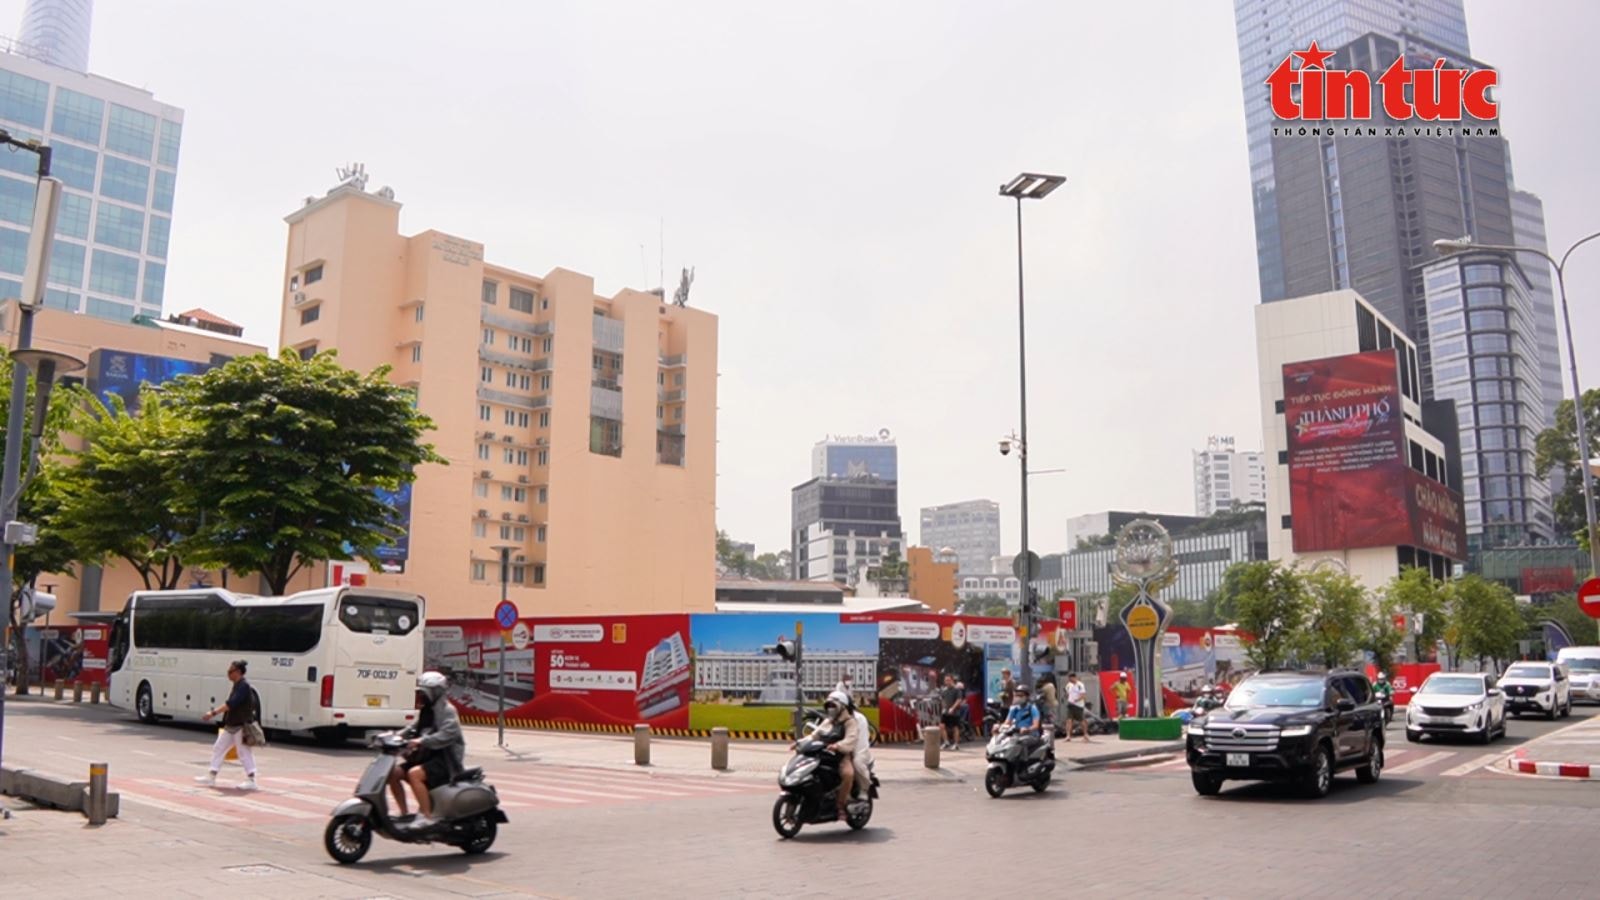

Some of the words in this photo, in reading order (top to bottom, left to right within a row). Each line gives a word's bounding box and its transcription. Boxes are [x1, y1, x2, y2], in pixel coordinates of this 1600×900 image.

[1290, 394, 1311, 405] TIẾP
[1313, 392, 1331, 403] TỤC
[1299, 405, 1353, 424] THÀNH
[1356, 396, 1391, 417] PHỐ
[550, 654, 565, 668] 50
